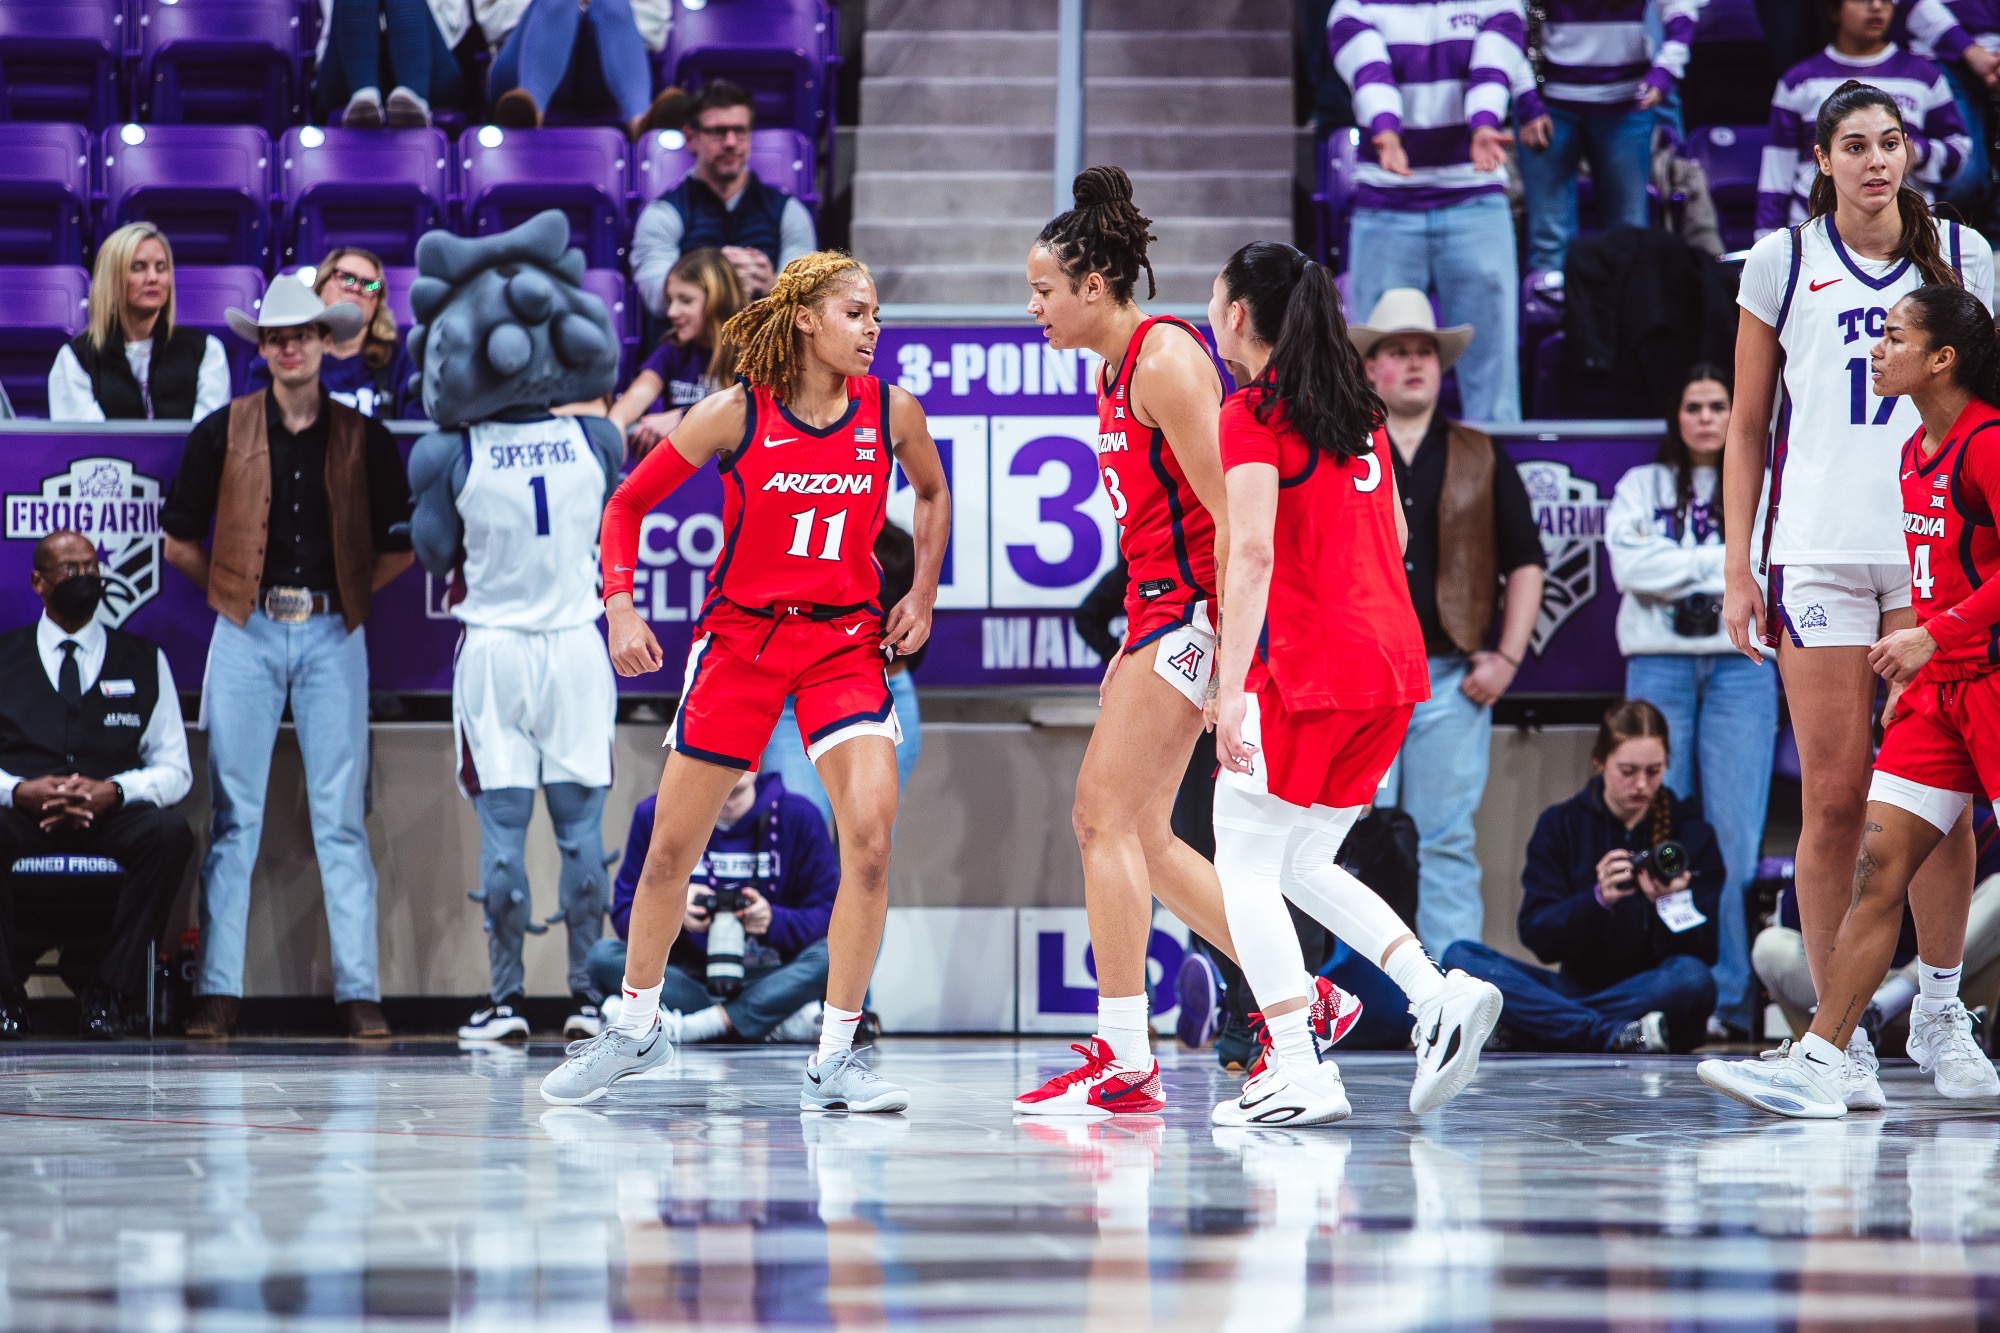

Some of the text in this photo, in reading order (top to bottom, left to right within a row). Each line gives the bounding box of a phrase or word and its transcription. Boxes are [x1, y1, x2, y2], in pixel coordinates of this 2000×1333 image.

[1838, 307, 1889, 345] TC
[490, 440, 576, 470] SUPERFROG
[855, 447, 876, 462] XII
[761, 472, 873, 494] ARIZONA
[1104, 466, 1128, 520] 3
[12, 502, 93, 533] FROG
[528, 475, 550, 536] 1
[1929, 495, 1946, 509] XII
[785, 506, 848, 562] 11
[1902, 511, 1946, 539] RIZONA
[1912, 543, 1936, 600] 4
[982, 615, 1128, 670] MAD
[1167, 642, 1205, 682] A
[69, 857, 118, 873] FROGS
